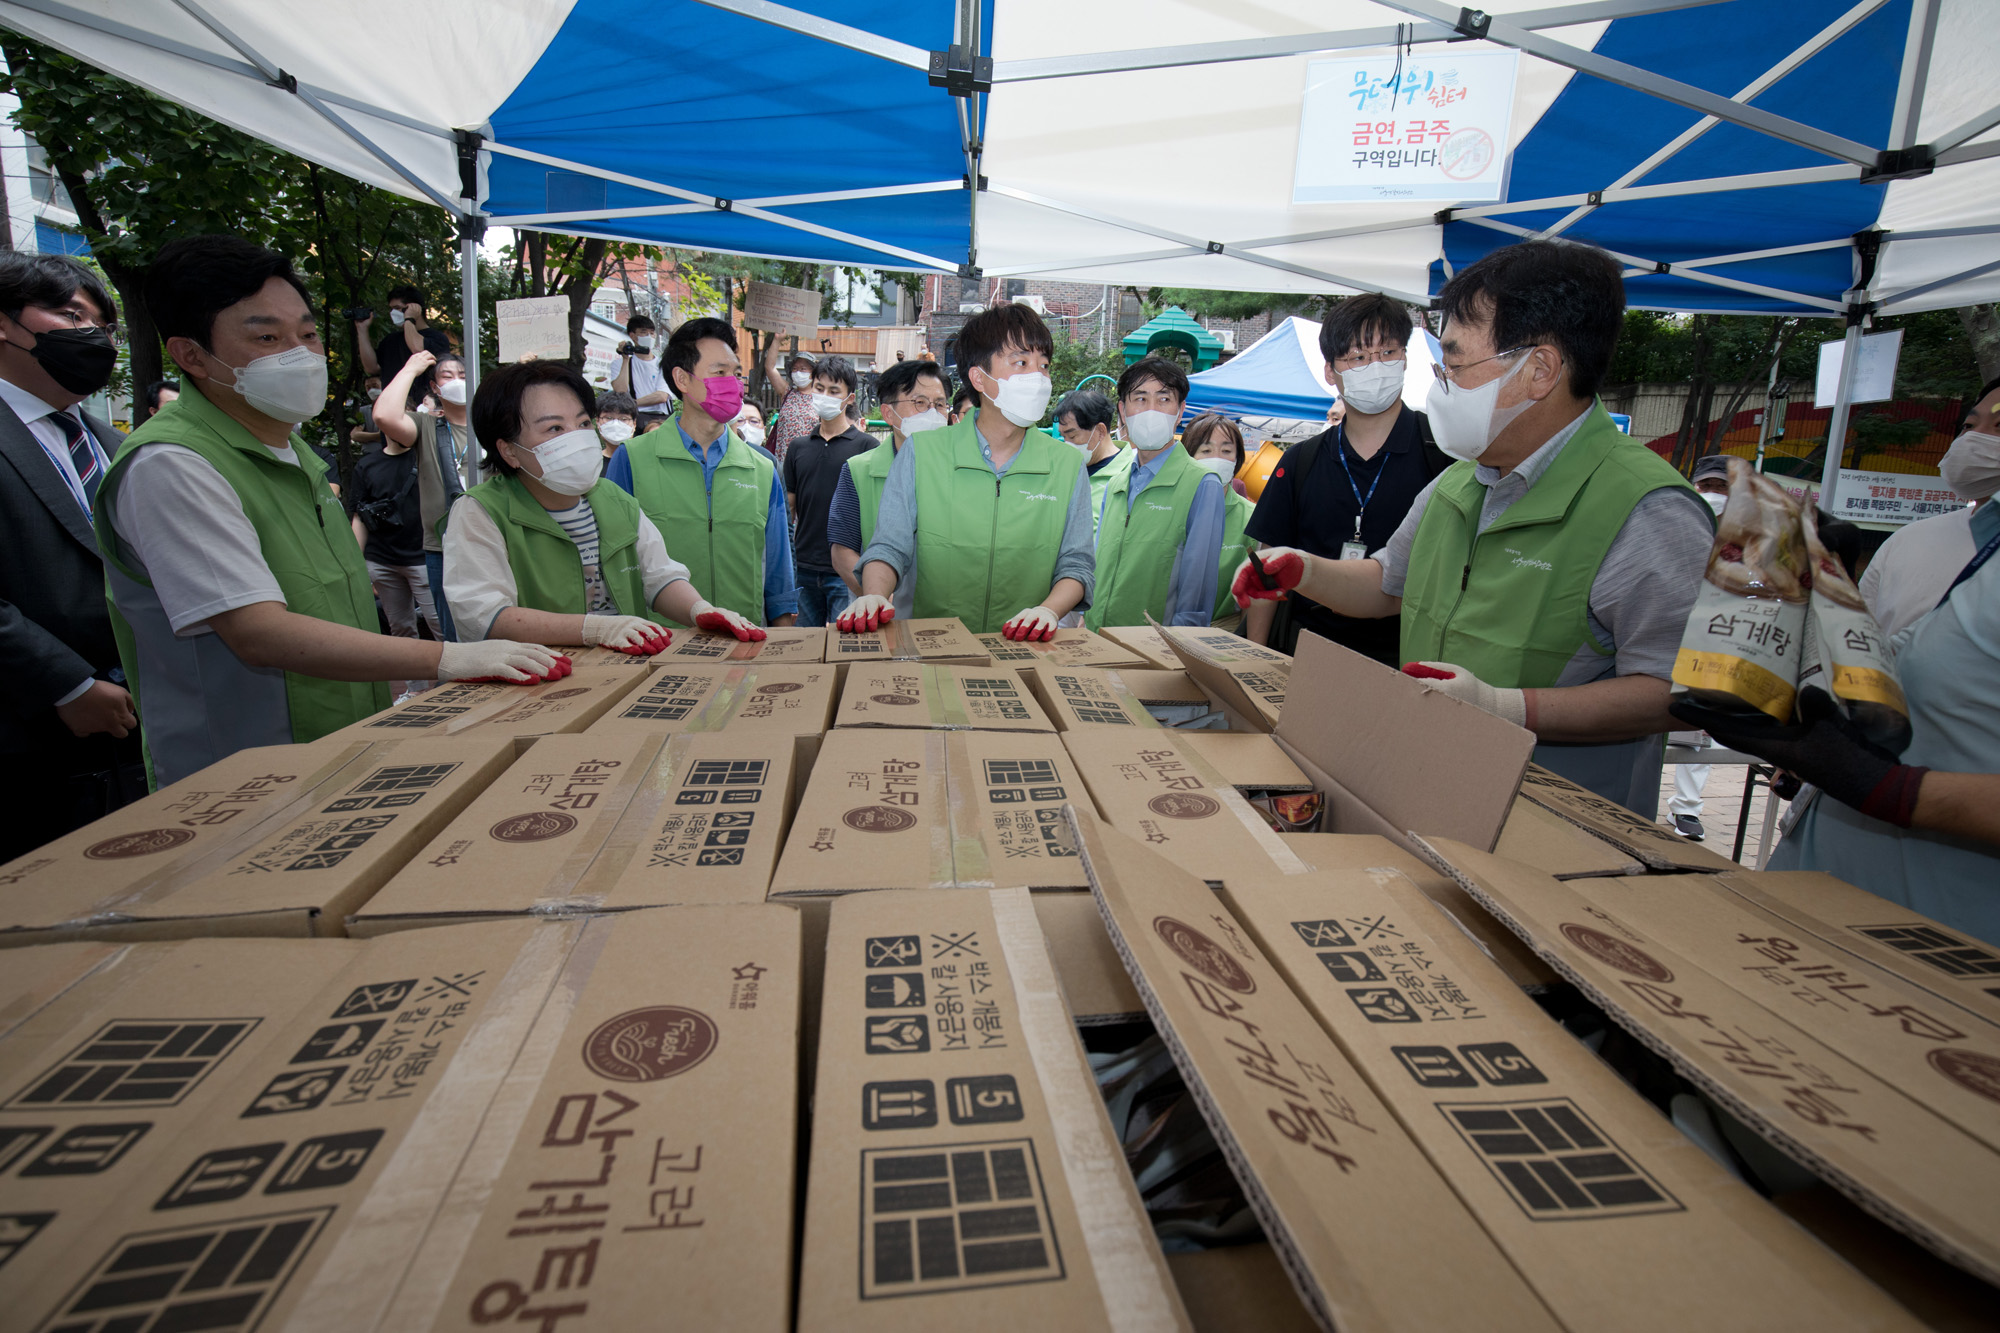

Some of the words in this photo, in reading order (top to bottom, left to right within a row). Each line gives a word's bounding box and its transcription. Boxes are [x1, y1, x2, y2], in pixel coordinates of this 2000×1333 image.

[1349, 70, 1434, 111] 무더위
[1427, 85, 1468, 109] 쉼터
[1352, 149, 1442, 168] 구역입니다.
[1845, 497, 1871, 509] 동자동
[1870, 499, 1902, 512] 쪽방주민
[1911, 501, 1942, 515] 서울지역
[1740, 603, 1782, 623] 고려
[1708, 613, 1792, 657] 삼계탕
[522, 774, 566, 796] 고려
[549, 759, 622, 811] 삼계탕
[846, 771, 877, 791] 고려
[879, 758, 921, 806] 삼계탕
[1112, 763, 1148, 781] 고려
[1136, 750, 1204, 791] 삼계탕
[162, 791, 226, 813] 고려
[179, 773, 298, 827] 삼계탕
[661, 813, 688, 834] 개봉시
[682, 813, 711, 842] 사용금지
[992, 811, 1012, 830] 개봉시
[997, 831, 1013, 845] 박스
[1013, 810, 1036, 836] 사용금지
[651, 836, 674, 851] 박스
[677, 842, 699, 850] 칼
[931, 964, 959, 980] 칼
[966, 962, 992, 995] 박스
[1369, 944, 1397, 958] 칼
[1385, 961, 1456, 1021] 사용금지
[1401, 942, 1433, 970] 박스
[1429, 974, 1487, 1020] 개봉시
[1737, 933, 1969, 1042] 삼계탕
[1742, 966, 1849, 1013] 고려
[738, 982, 759, 1010] 아워홈
[394, 1007, 432, 1025] 칼
[424, 1001, 471, 1038] 박스
[934, 983, 971, 1051] 사용금지
[972, 1000, 1008, 1049] 개봉시
[657, 1017, 696, 1065] Fresh
[1734, 1025, 1861, 1093] 고려
[330, 1029, 415, 1106] 사용금지
[376, 1041, 442, 1100] 개봉시
[1180, 970, 1358, 1174] 삼계탕
[1494, 1055, 1532, 1072] 5
[1620, 979, 1879, 1143] 삼계탕
[976, 1090, 1016, 1108] 5
[1283, 1043, 1378, 1134] 고려
[316, 1148, 368, 1171] 5
[622, 1137, 704, 1233] 고려
[470, 1090, 640, 1333] 삼계탕
